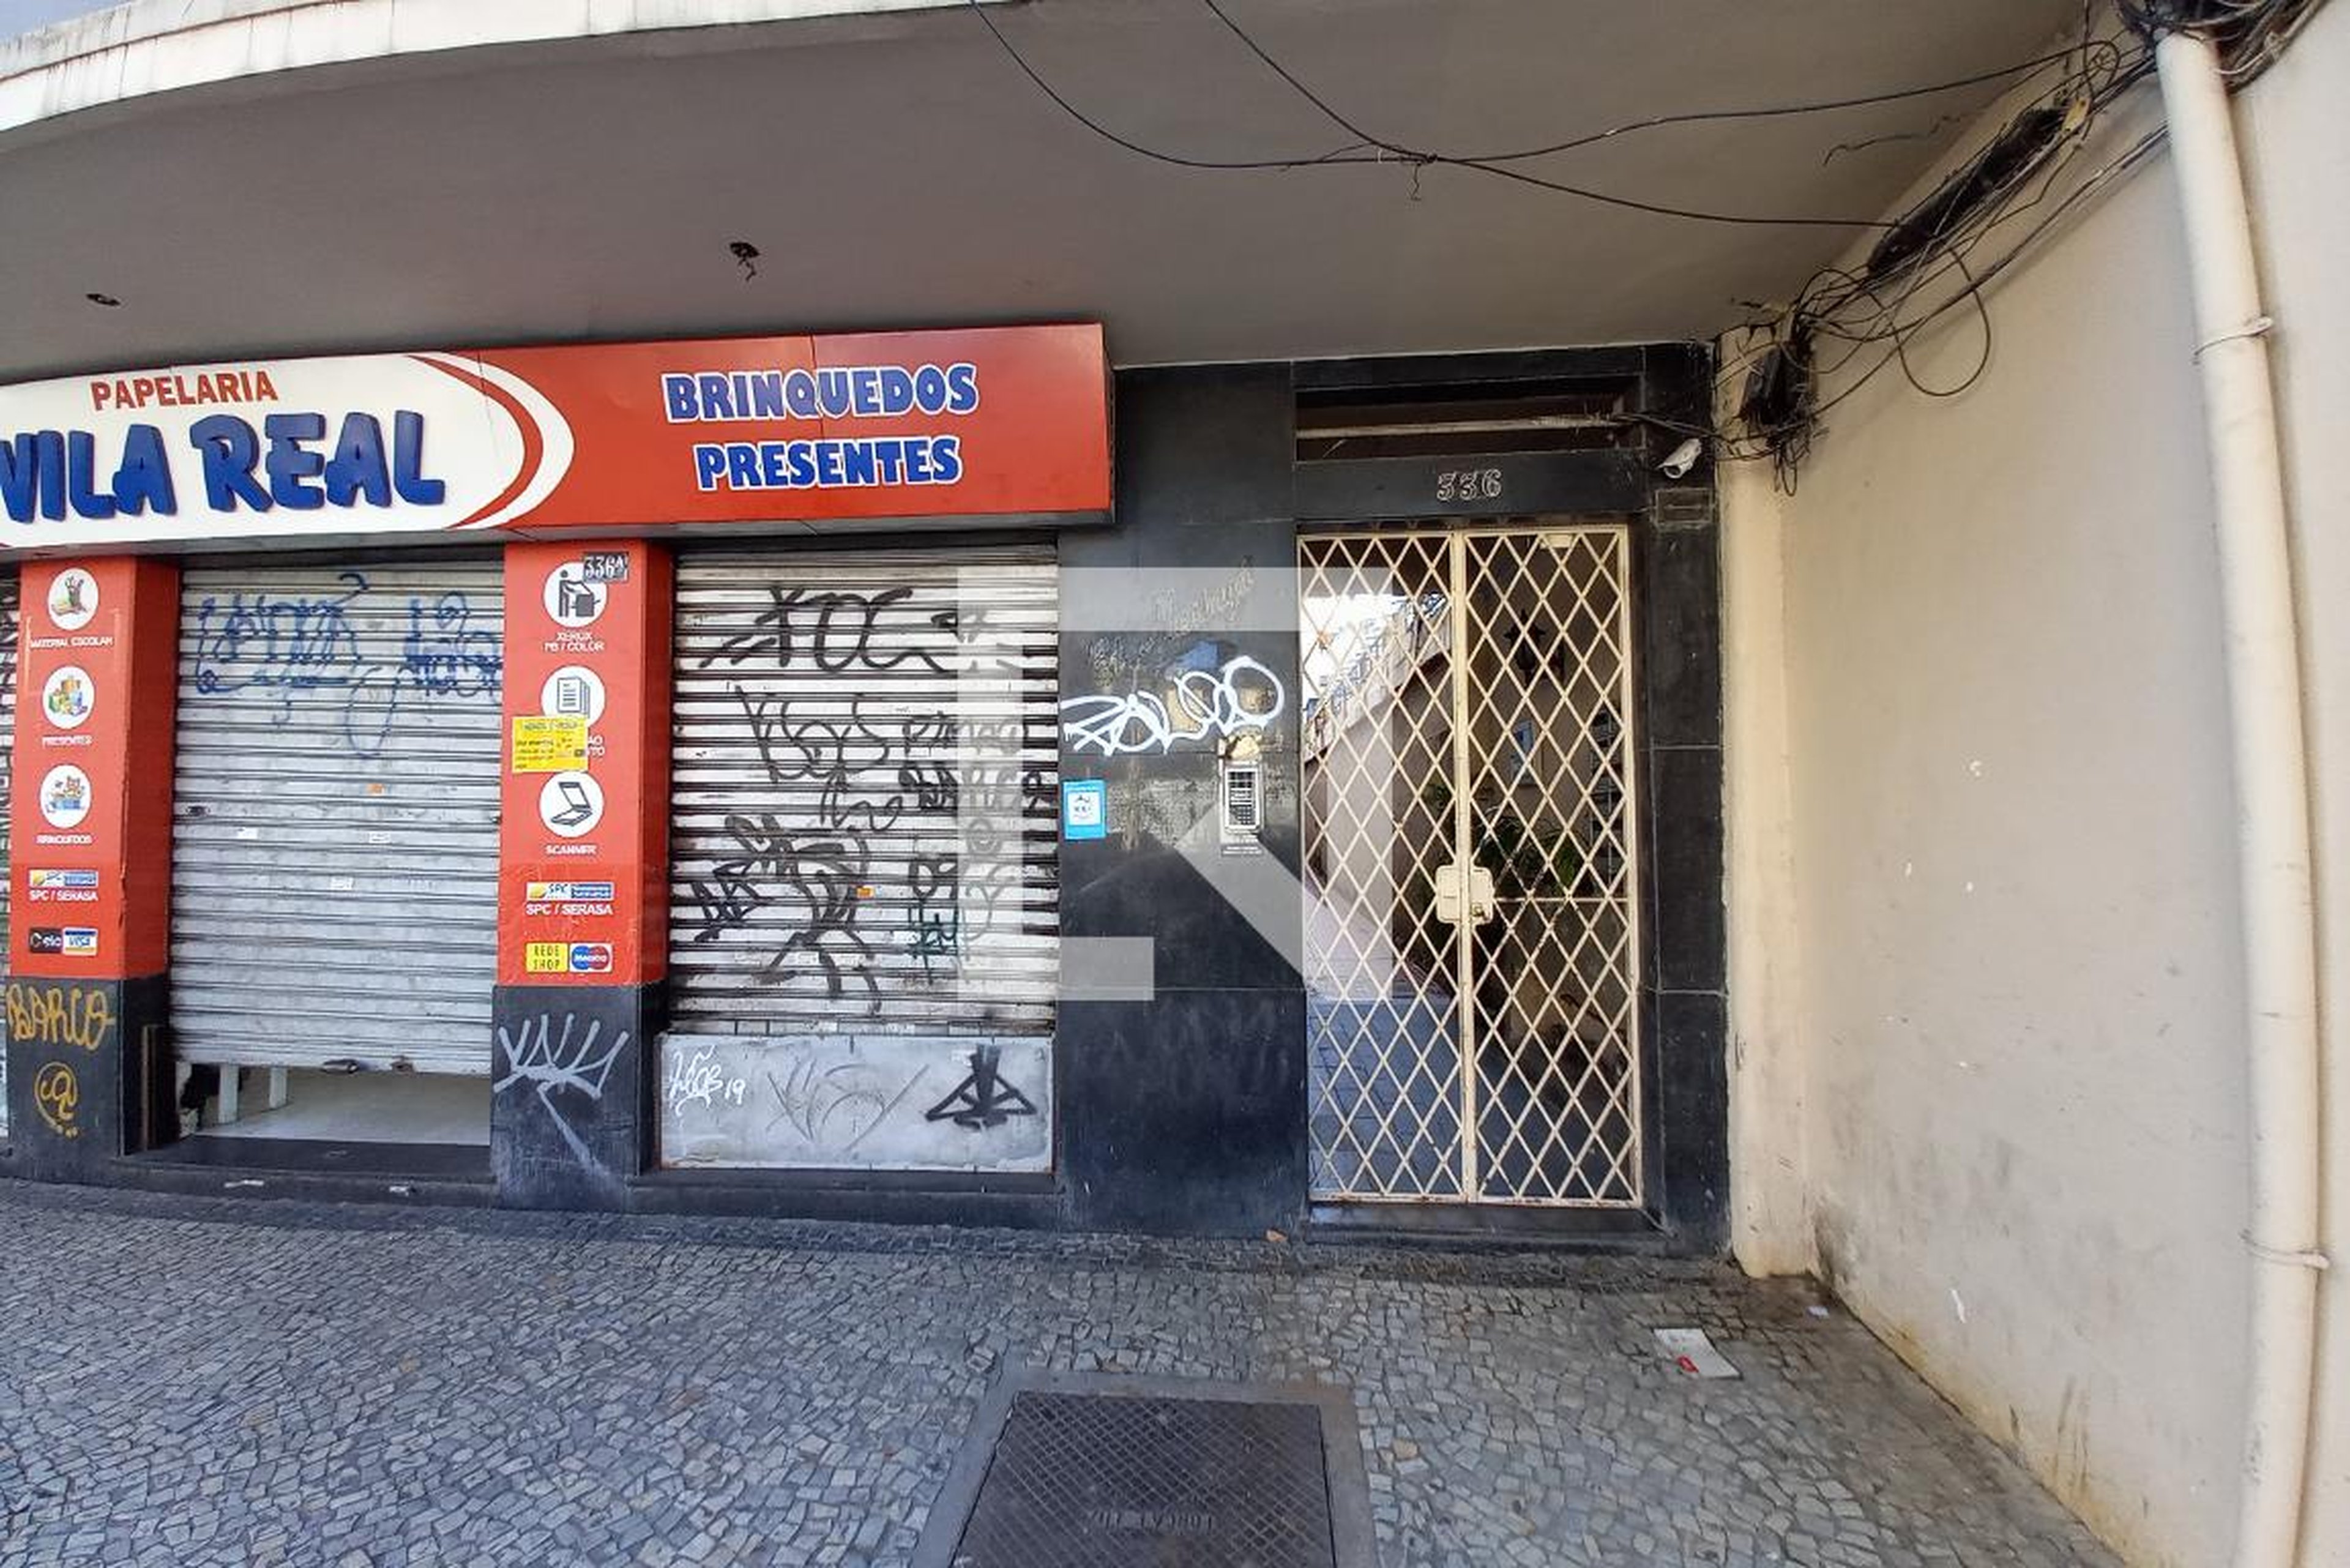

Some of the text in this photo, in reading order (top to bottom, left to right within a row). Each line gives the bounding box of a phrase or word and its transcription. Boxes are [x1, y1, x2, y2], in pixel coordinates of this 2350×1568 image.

[91, 370, 278, 411] PAPELARIA
[662, 363, 980, 424] BRINQUEDOS
[0, 409, 446, 524] VILA REAL
[694, 435, 964, 491] PRESENTES
[1437, 468, 1502, 501] 336
[545, 845, 597, 856] SCANNER
[29, 890, 50, 901] SPC
[57, 890, 99, 902] SERASA
[526, 903, 551, 916] SPC
[561, 903, 614, 916] SERASA
[534, 944, 560, 957] REDE
[533, 958, 560, 970] SHOP
